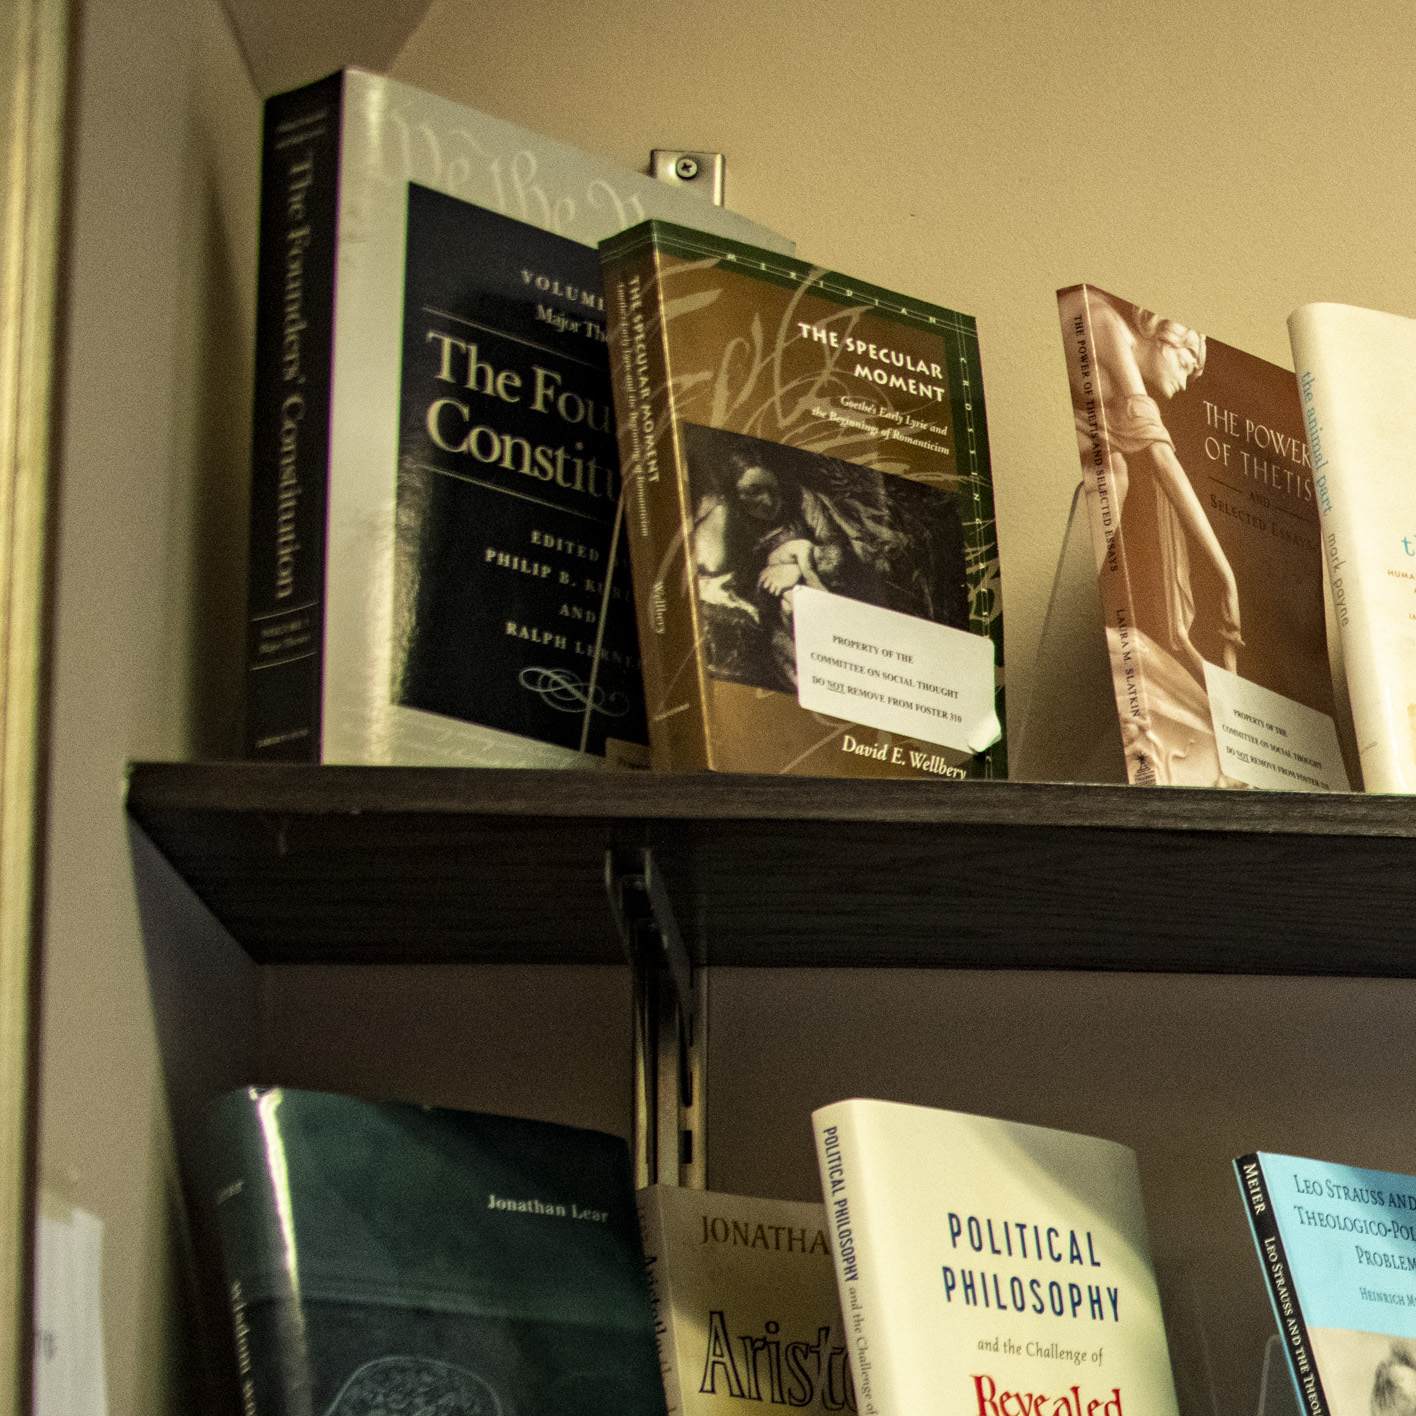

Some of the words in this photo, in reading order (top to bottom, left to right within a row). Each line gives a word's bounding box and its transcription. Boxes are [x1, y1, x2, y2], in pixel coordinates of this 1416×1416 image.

[798, 322, 839, 348] THE
[846, 333, 944, 379] SPECULAR
[855, 364, 945, 402] MOMENT
[1202, 400, 1240, 436] THE
[1245, 419, 1312, 469] POWER
[1205, 436, 1232, 467] OF
[1240, 450, 1313, 503] THETIS
[275, 394, 305, 600] Constitution
[1116, 608, 1129, 648] LAURA
[1122, 650, 1133, 668] M.
[1125, 668, 1140, 718] SLATKIN
[842, 735, 887, 761] David
[891, 748, 906, 766] E.
[909, 752, 966, 780] Wellbery
[487, 1193, 567, 1220] Jonathan
[571, 1204, 609, 1225] Lear
[947, 1210, 1103, 1268] POLITICAL
[941, 1266, 1122, 1323] PHILOSOPHY
